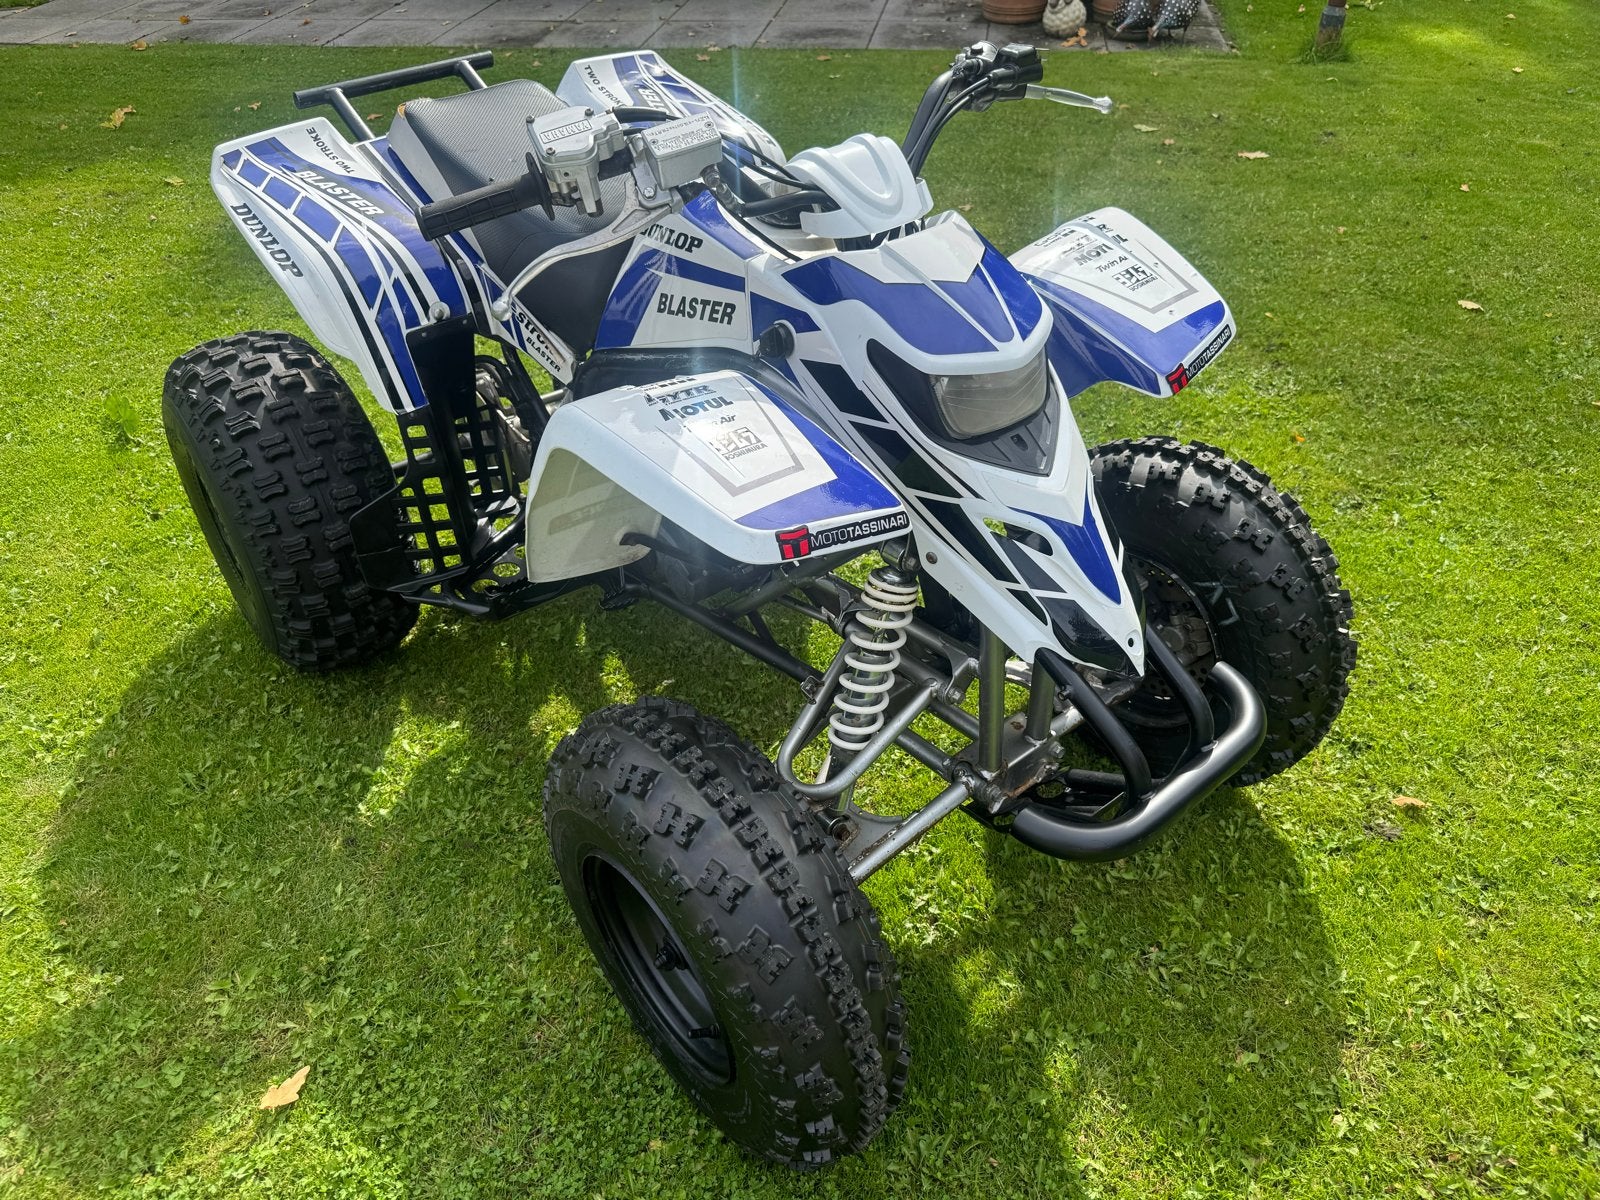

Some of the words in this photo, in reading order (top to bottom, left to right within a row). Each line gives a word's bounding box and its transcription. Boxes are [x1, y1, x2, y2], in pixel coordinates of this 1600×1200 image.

[584, 65, 600, 85] TWO
[306, 127, 338, 161] STROKE
[543, 121, 590, 142] YAMAHA
[335, 160, 355, 174] TWO
[297, 169, 384, 216] BLASTER
[231, 203, 303, 278] DUNLOP
[656, 292, 736, 325] BLASTER
[526, 336, 561, 373] BLASTER
[1186, 327, 1231, 379] MOTOTASSINARI
[720, 415, 736, 425] Air
[811, 514, 907, 548] MOTOTASSINARI
